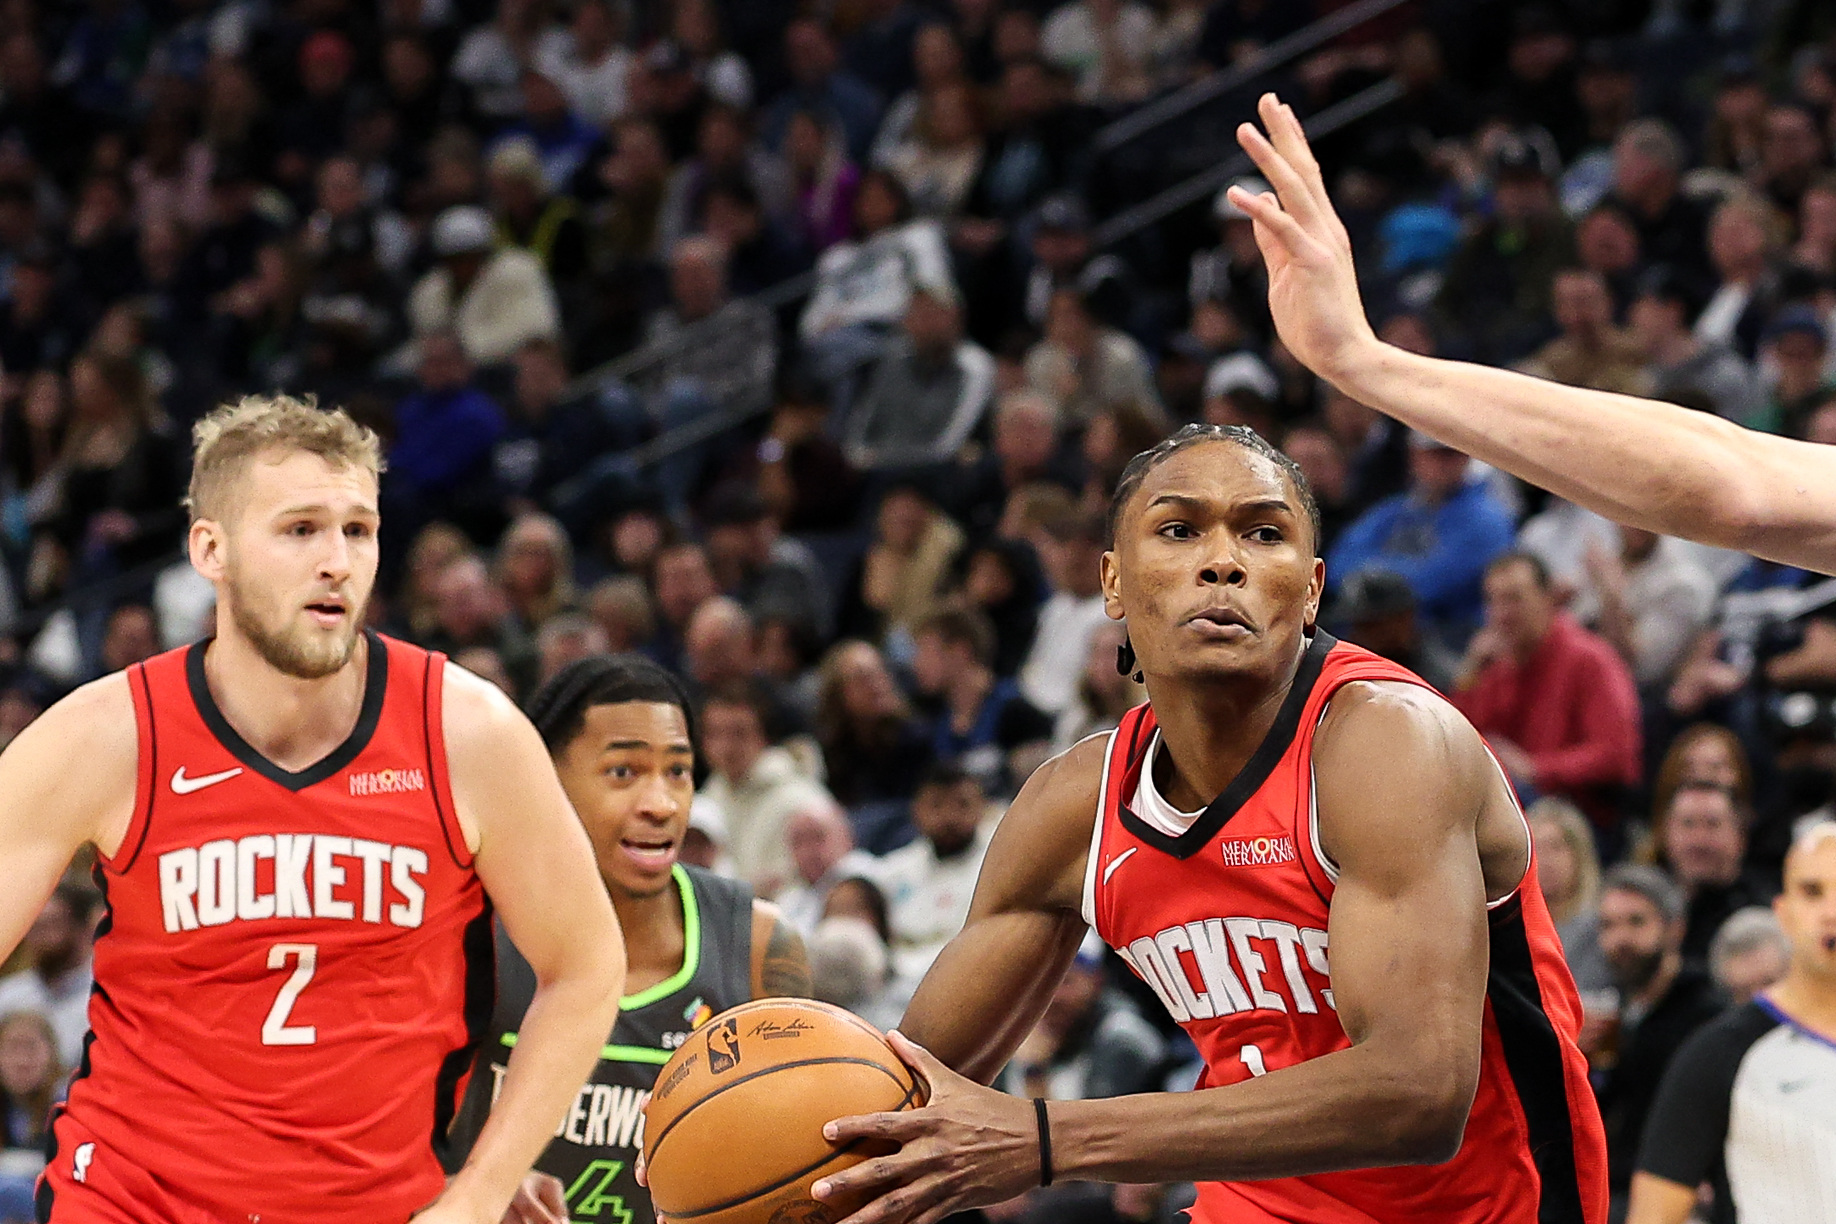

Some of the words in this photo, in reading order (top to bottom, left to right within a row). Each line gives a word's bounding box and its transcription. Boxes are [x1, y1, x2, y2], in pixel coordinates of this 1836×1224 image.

[158, 833, 428, 934] ROCKETS
[261, 942, 318, 1046] 2
[1115, 917, 1338, 1022] OCKETS
